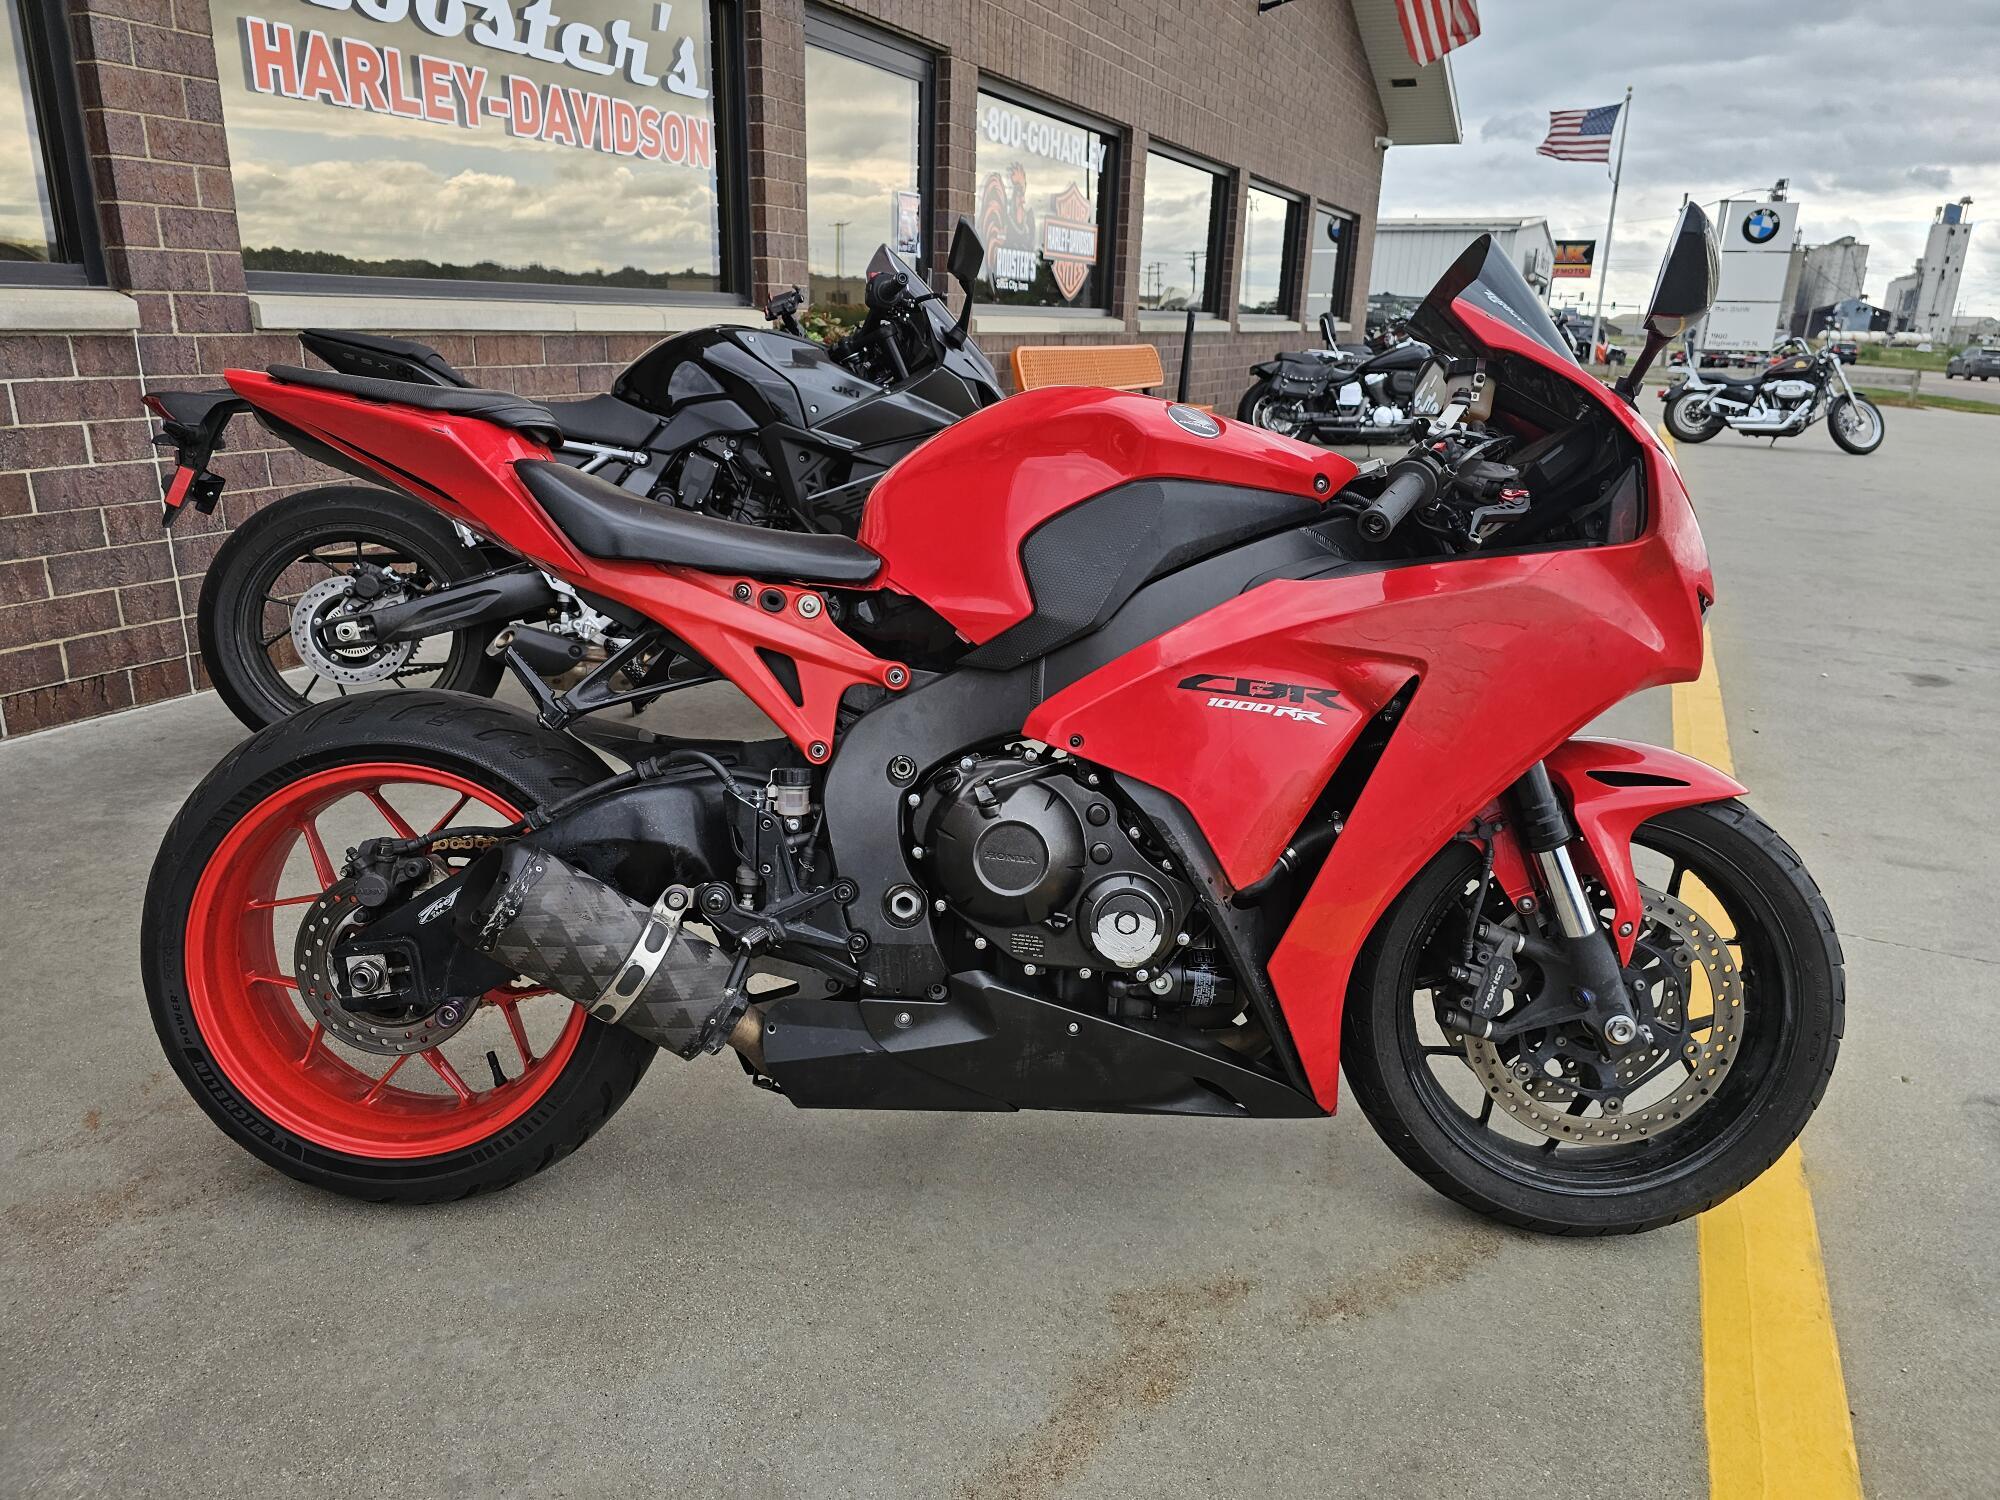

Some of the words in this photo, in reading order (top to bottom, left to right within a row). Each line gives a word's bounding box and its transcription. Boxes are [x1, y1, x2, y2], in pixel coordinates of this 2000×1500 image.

[308, 0, 709, 98] oster's
[246, 16, 711, 169] HARLEY-DAVIDSON
[979, 106, 1107, 173] -800-GOHARLEY
[996, 248, 1037, 283] ROOSTER'S
[1047, 224, 1096, 258] HARLEY-DAVIDSON
[1177, 674, 1352, 712] CBR
[984, 850, 1038, 865] HONDA
[1483, 964, 1505, 1010] TOKICO
[170, 992, 193, 1046] POWER
[192, 1056, 270, 1138] MICHELIN
